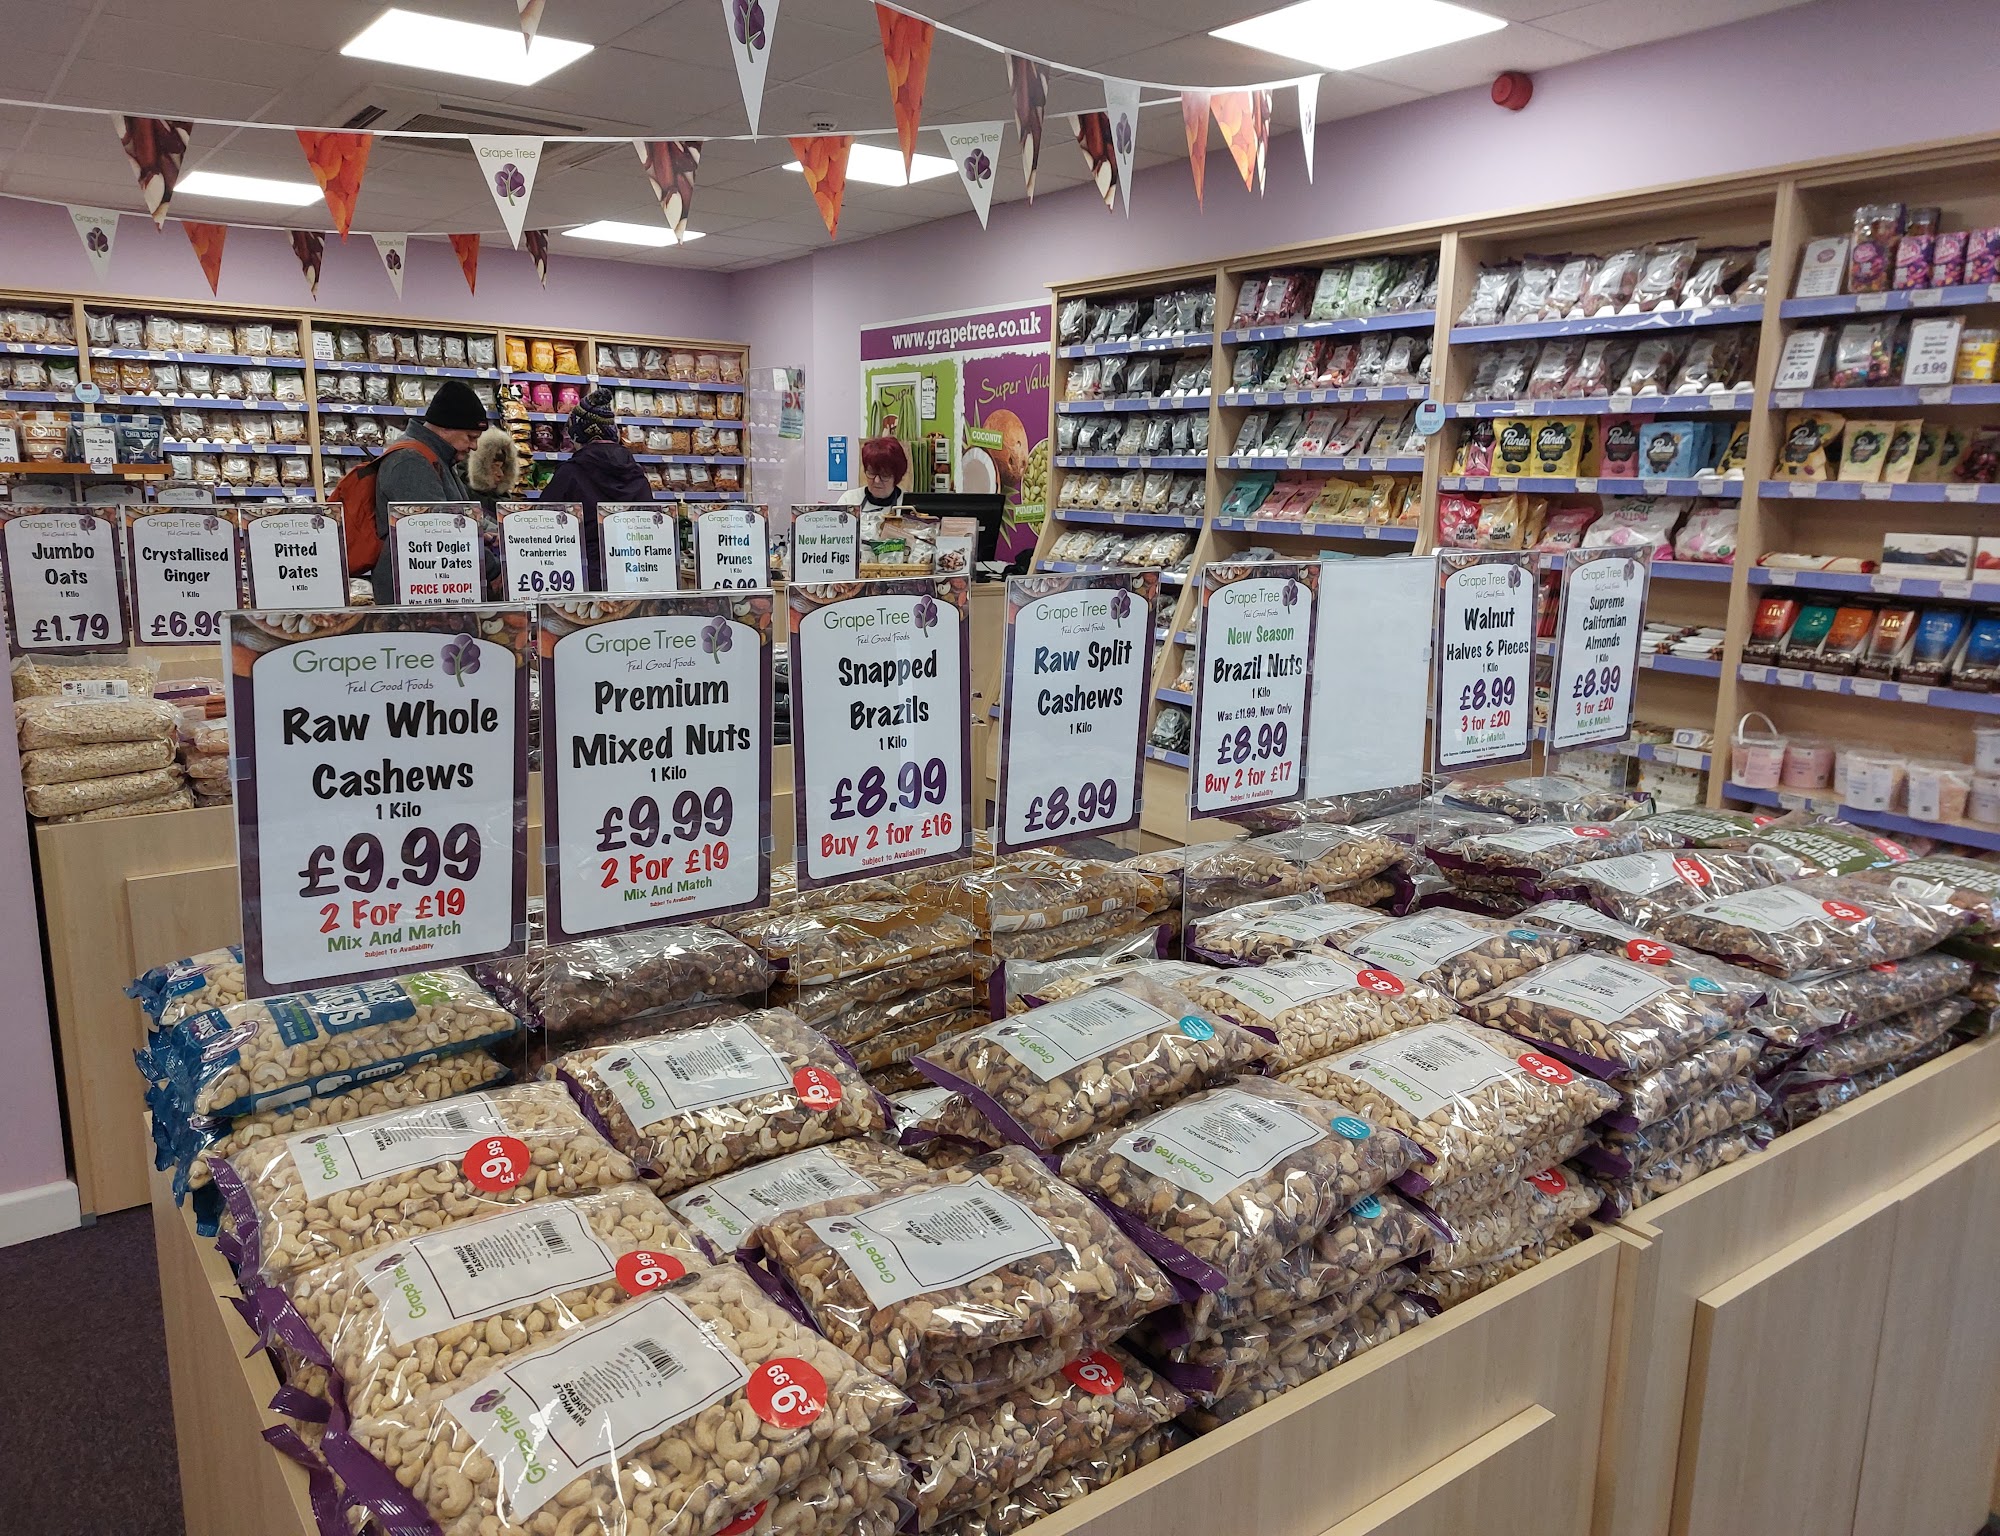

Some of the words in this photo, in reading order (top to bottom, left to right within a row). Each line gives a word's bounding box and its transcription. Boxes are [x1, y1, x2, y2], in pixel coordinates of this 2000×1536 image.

[950, 136, 979, 146] Grape
[980, 134, 999, 143] Tree
[480, 147, 513, 160] Grape
[515, 148, 536, 158] Tree
[892, 311, 1041, 351] www.grapetree.co.uk
[979, 377, 1021, 404] Super
[1024, 363, 1050, 394] Valu
[972, 430, 1003, 444] COCONUT
[1503, 429, 1530, 446] Panda
[1539, 429, 1566, 446] Panda
[1608, 428, 1636, 445] Panda
[1015, 504, 1044, 515] PUMPKIN
[508, 534, 552, 544] Sweetened
[554, 534, 576, 544] Dried
[626, 532, 654, 542] Chilean
[718, 534, 750, 548] Pitted
[798, 534, 816, 545] New
[818, 534, 854, 545] Harvest
[32, 543, 95, 560] Jumbo
[142, 546, 229, 565] Crystallised
[274, 542, 318, 558] Pitted
[408, 541, 433, 554] Soft
[436, 541, 471, 556] Deglet
[519, 548, 567, 558] Cranberries
[609, 546, 641, 558] Jumbo
[644, 545, 672, 556] Flame
[802, 552, 828, 564] Dried
[831, 552, 850, 565] Figs
[408, 557, 438, 570] Nour
[440, 557, 473, 570] Dates
[625, 562, 658, 574] Raisins
[717, 553, 753, 566] Prunes
[45, 568, 88, 585] Oats
[164, 569, 211, 585] Ginger
[278, 564, 318, 580] Dates
[518, 570, 575, 592] £6.99
[1458, 574, 1487, 588] Grape
[1488, 572, 1506, 586] Tree
[1581, 568, 1606, 581] Grape
[1607, 566, 1622, 578] Tree
[410, 584, 438, 595] PRICE
[442, 583, 473, 594] DROP!
[1224, 590, 1257, 606] Grape
[1258, 588, 1280, 602] Tree
[1036, 604, 1078, 623] Grape
[1080, 601, 1108, 616] Tree
[1589, 595, 1625, 612] Supreme
[32, 613, 110, 642] £1.79
[824, 611, 875, 632] Grape
[876, 608, 910, 626] Tree
[1464, 606, 1515, 631] Walnut
[1582, 615, 1627, 632] Californian
[584, 632, 650, 656] Grape
[653, 629, 697, 650] Tree
[1227, 627, 1252, 646] New
[1256, 625, 1295, 644] Season
[1585, 635, 1620, 650] Almonds
[1034, 645, 1080, 675] Raw
[1087, 638, 1133, 672] Split
[1446, 642, 1482, 661] Halves
[1486, 640, 1494, 656] &
[1498, 638, 1529, 656] Pieces
[292, 650, 377, 677] Grape
[380, 647, 435, 669] Tree
[838, 649, 938, 687] Snapped
[1213, 654, 1262, 684] Brazil
[1267, 652, 1303, 678] Nuts
[346, 681, 368, 694] Feel
[370, 680, 403, 692] Good
[404, 678, 434, 690] Foods
[1252, 688, 1256, 699] 1
[1257, 686, 1271, 698] Kilo
[1572, 665, 1621, 699] £8.99
[594, 678, 729, 715] Premium
[1037, 684, 1123, 716] Cashews
[1459, 676, 1516, 711] £8.99
[850, 696, 930, 731] Brazils
[1217, 710, 1233, 722] Was
[1234, 706, 1258, 720] £11.99,
[1260, 705, 1275, 717] Now
[1277, 703, 1292, 716] Only
[1576, 702, 1582, 716] 3
[1584, 700, 1595, 714] for
[1597, 696, 1614, 712] £20
[282, 706, 370, 746] Raw
[386, 698, 498, 738] Whole
[1460, 716, 1468, 733] 3
[1471, 716, 1486, 730] for
[1489, 710, 1511, 728] £20
[572, 726, 674, 769] Mixed
[686, 724, 751, 756] Nuts
[879, 738, 884, 750] 1
[888, 736, 908, 750] Kilo
[1217, 720, 1288, 765] £8.99
[312, 758, 474, 800] Cashews
[650, 768, 657, 783] 1
[661, 766, 687, 782] Kilo
[1204, 772, 1230, 795] Buy
[1234, 768, 1244, 789] 2
[1248, 766, 1266, 786] for
[1270, 760, 1292, 782] £17
[830, 757, 948, 821] £8.99
[375, 803, 383, 820] 1
[390, 801, 422, 819] Kilo
[1024, 778, 1118, 833] £8.99
[596, 786, 734, 852] £9.99
[821, 833, 859, 858] Buy
[866, 824, 880, 850] 2
[886, 822, 913, 846] for
[921, 812, 952, 838] £16
[298, 822, 482, 898] £9.99
[600, 857, 619, 889] 2
[629, 853, 674, 884] For
[684, 841, 730, 875] £19
[862, 854, 884, 866] Subject
[886, 853, 892, 862] to
[894, 846, 928, 860] Availability
[624, 889, 648, 902] Mix
[651, 884, 674, 897] And
[677, 876, 712, 893] Match
[319, 903, 341, 934] 2
[352, 900, 403, 930] For
[414, 888, 466, 920] £19
[327, 935, 363, 952] Mix
[369, 929, 402, 948] And
[408, 921, 462, 942] Match
[364, 949, 388, 958] Subject
[399, 942, 434, 955] Availability
[1365, 972, 1400, 993] £8.99
[1526, 1055, 1569, 1082] £8.99
[806, 1069, 834, 1105] £9.99
[480, 1140, 514, 1185] £9.99
[1153, 1144, 1178, 1166] Tree
[318, 1153, 339, 1181] Grape
[1175, 1158, 1214, 1184] Grape
[454, 1245, 471, 1266] WHOLE
[463, 1244, 486, 1272] CASHEWS
[864, 1246, 896, 1285] Grape
[467, 1265, 478, 1279] RAW
[401, 1279, 427, 1320] Grape
[551, 1382, 577, 1415] WHOLE
[562, 1381, 593, 1417] CASHEWS
[766, 1364, 816, 1417] £9.99
[571, 1412, 588, 1428] RAW
